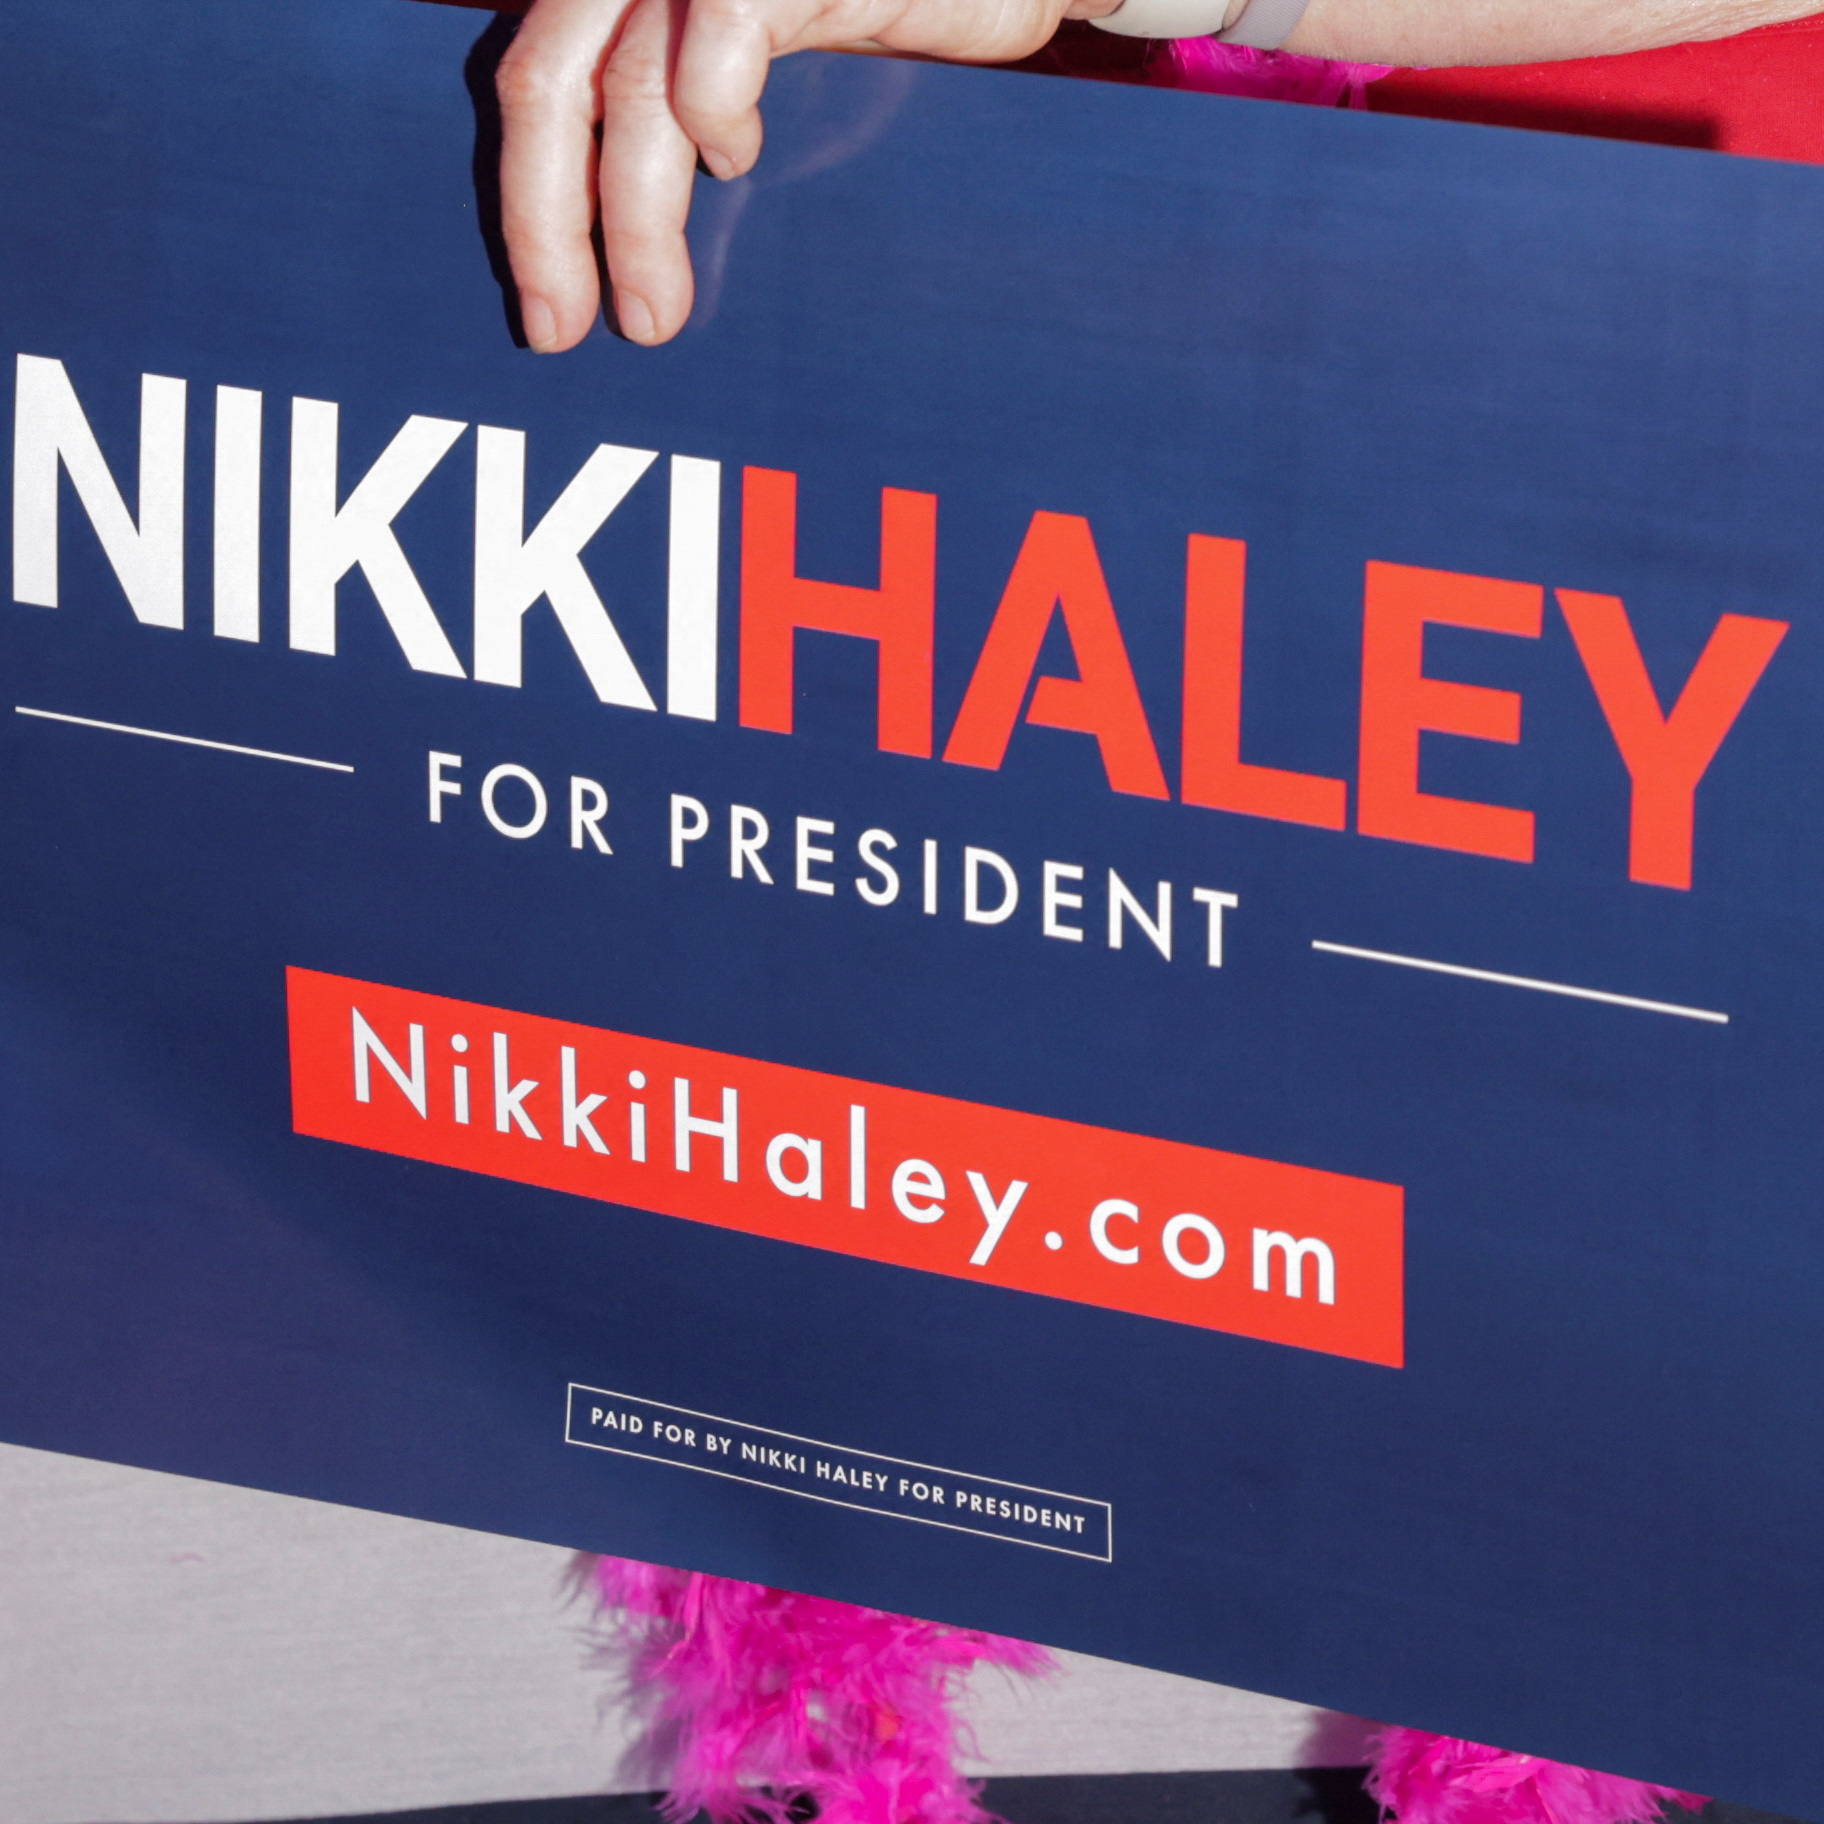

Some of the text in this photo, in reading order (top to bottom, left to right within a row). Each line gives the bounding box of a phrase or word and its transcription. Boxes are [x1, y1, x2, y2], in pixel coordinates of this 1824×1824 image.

[428, 750, 1239, 968] FOR PRESIDENT
[351, 1005, 1337, 1306] NikkiHaley.com
[590, 1406, 1086, 1535] PAID FOR BY NIKKI HALEY FOR PRESIDENT
